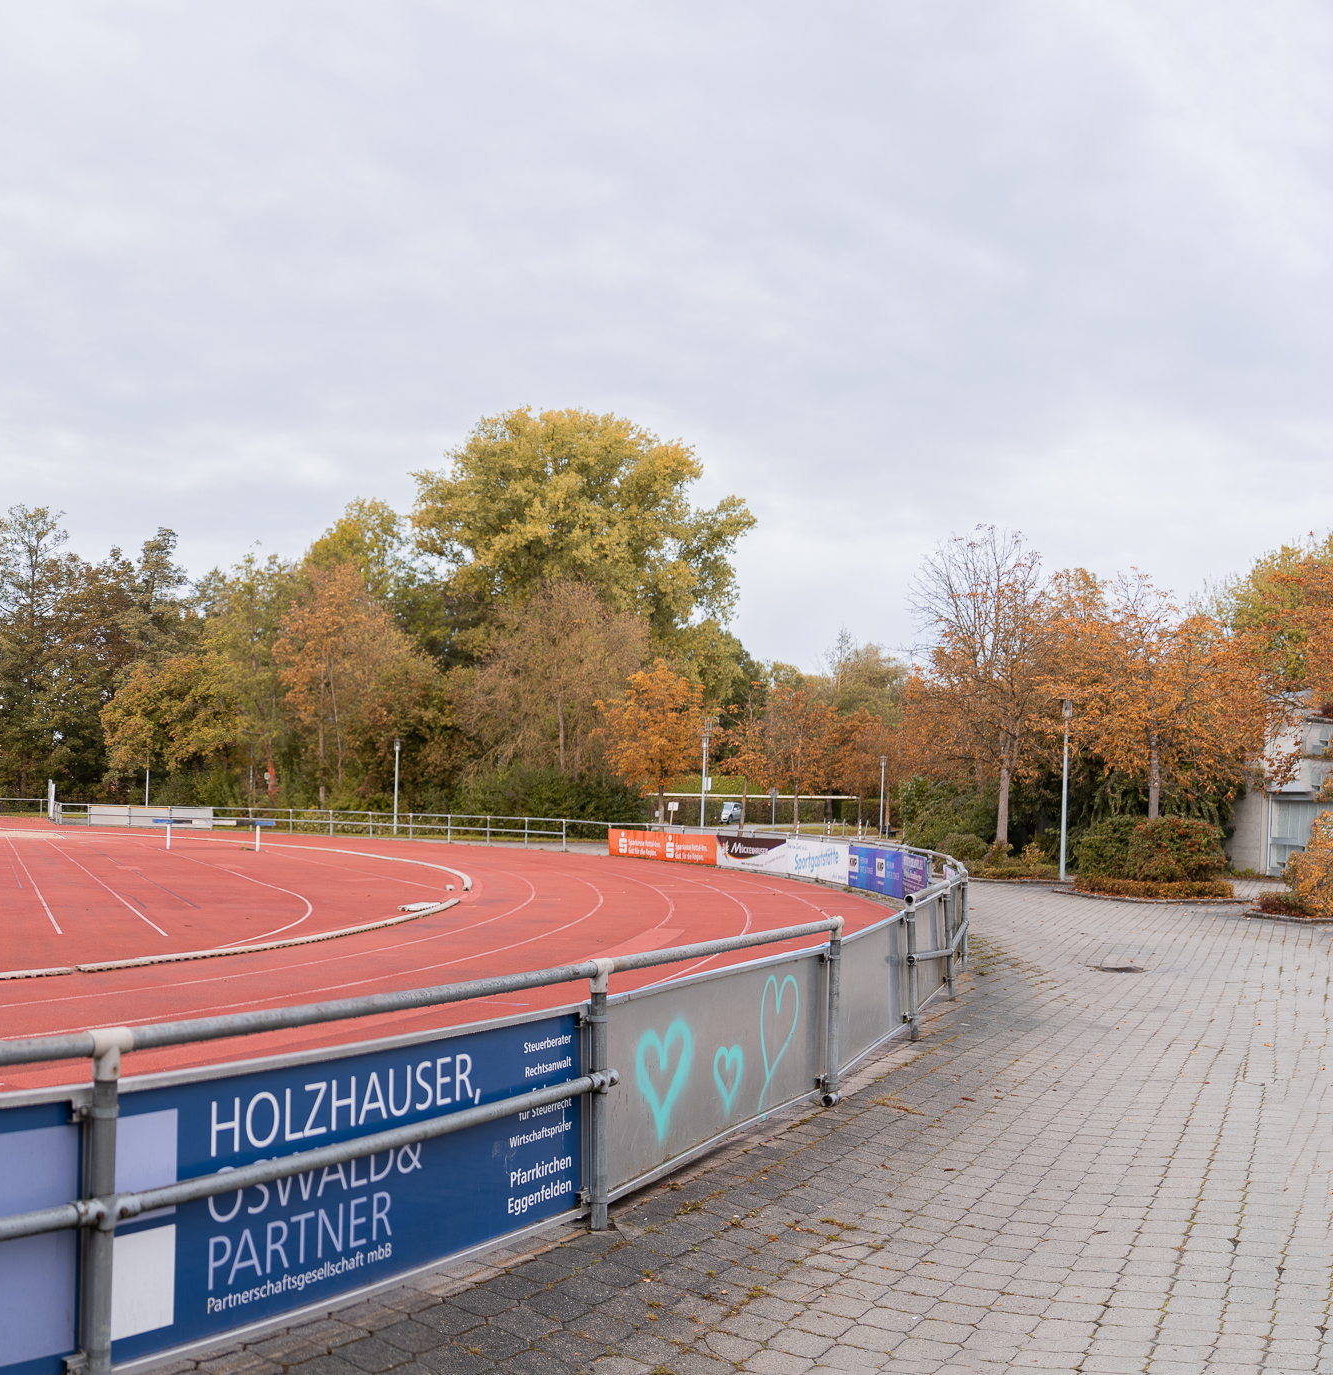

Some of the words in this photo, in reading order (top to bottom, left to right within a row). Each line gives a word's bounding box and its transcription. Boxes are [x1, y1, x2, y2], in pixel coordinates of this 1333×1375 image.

[628, 839, 645, 847] Sparkasse
[645, 849, 657, 857] Region.
[675, 843, 691, 851] Sparkasse
[692, 854, 704, 862] Region.
[794, 847, 839, 874] Sportgaststätte
[523, 1035, 571, 1054] Steuerberater
[525, 1056, 571, 1077] Rechtsanwalt
[210, 1053, 481, 1157] HOLZHAUSER,
[531, 1098, 571, 1118] Steuerrecht
[509, 1121, 572, 1148] Wirtschaftsprüfer
[510, 1156, 572, 1187] Pfarrkirchen
[507, 1180, 572, 1216] Eggenfelden
[207, 1191, 392, 1290] PARTNER
[207, 1252, 364, 1314] Partnerschaftsgesellschaft
[367, 1242, 392, 1263] mbB
